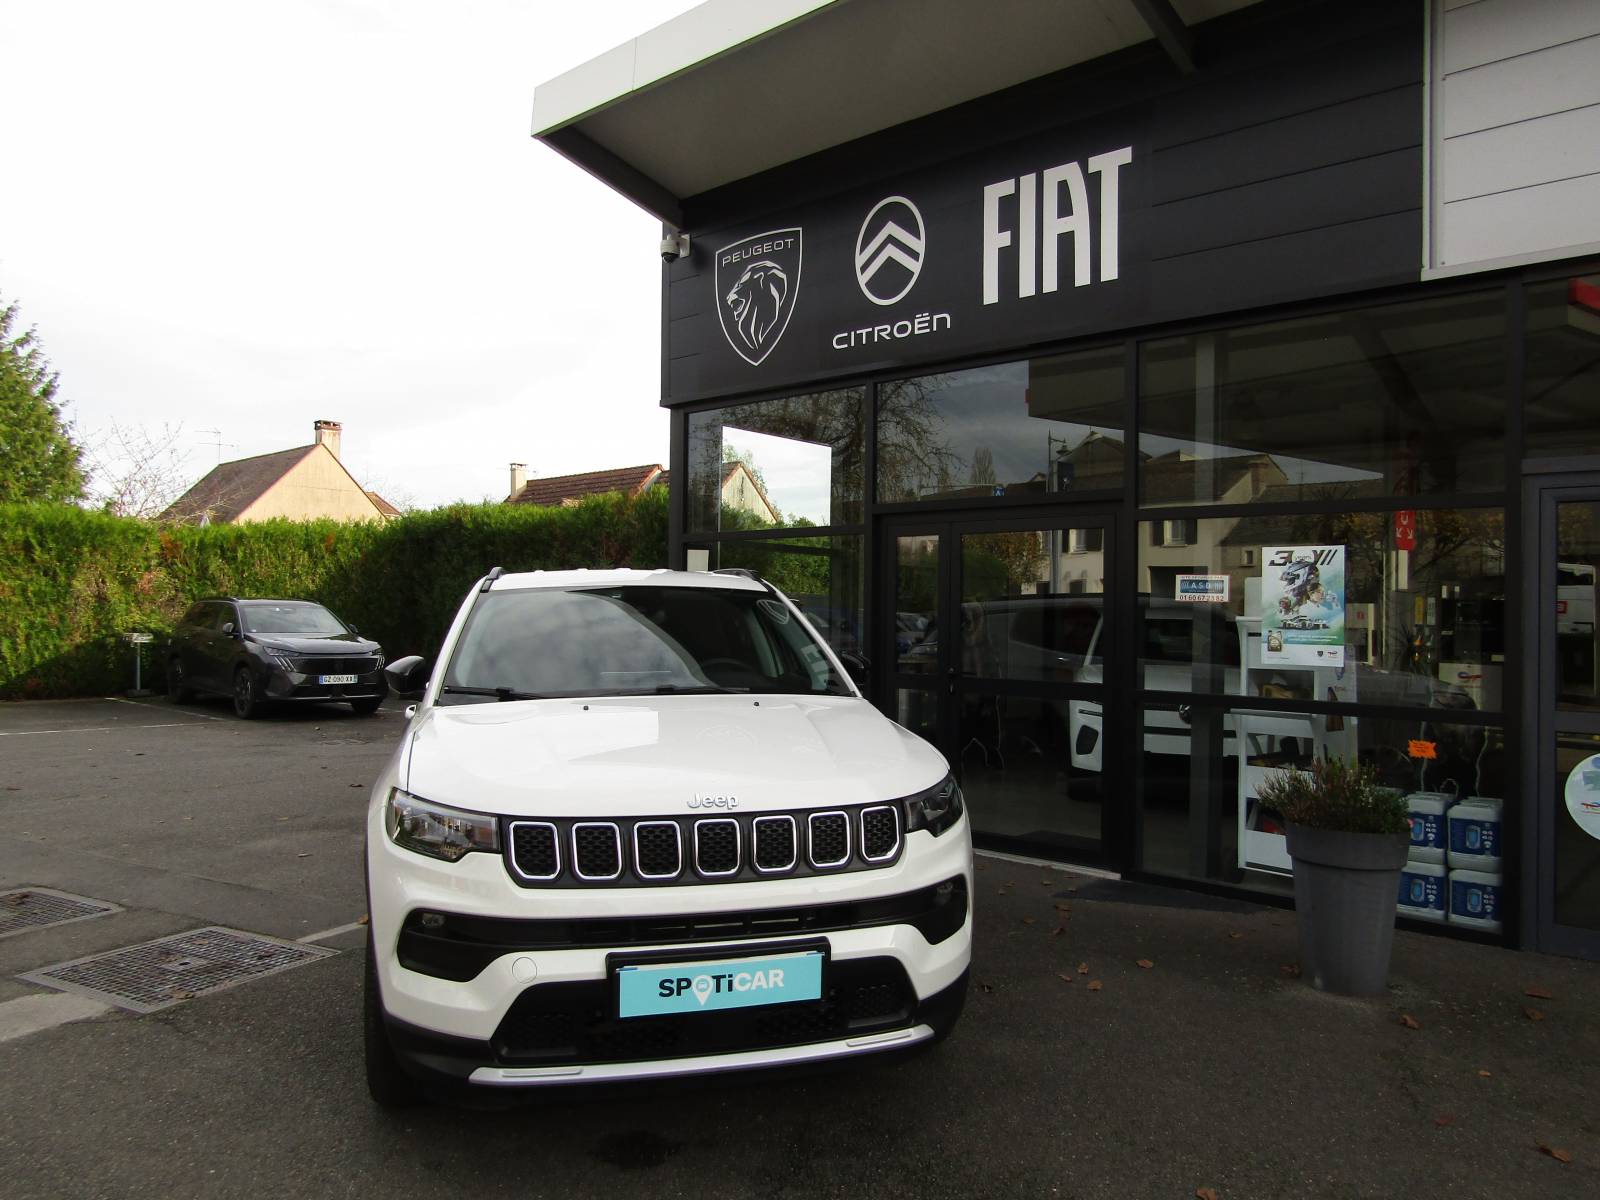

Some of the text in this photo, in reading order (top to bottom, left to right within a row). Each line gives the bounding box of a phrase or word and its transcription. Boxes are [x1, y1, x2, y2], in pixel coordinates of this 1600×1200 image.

[983, 146, 1133, 305] FIAT
[722, 238, 794, 268] PEUGEOT
[687, 792, 739, 810] Jeep
